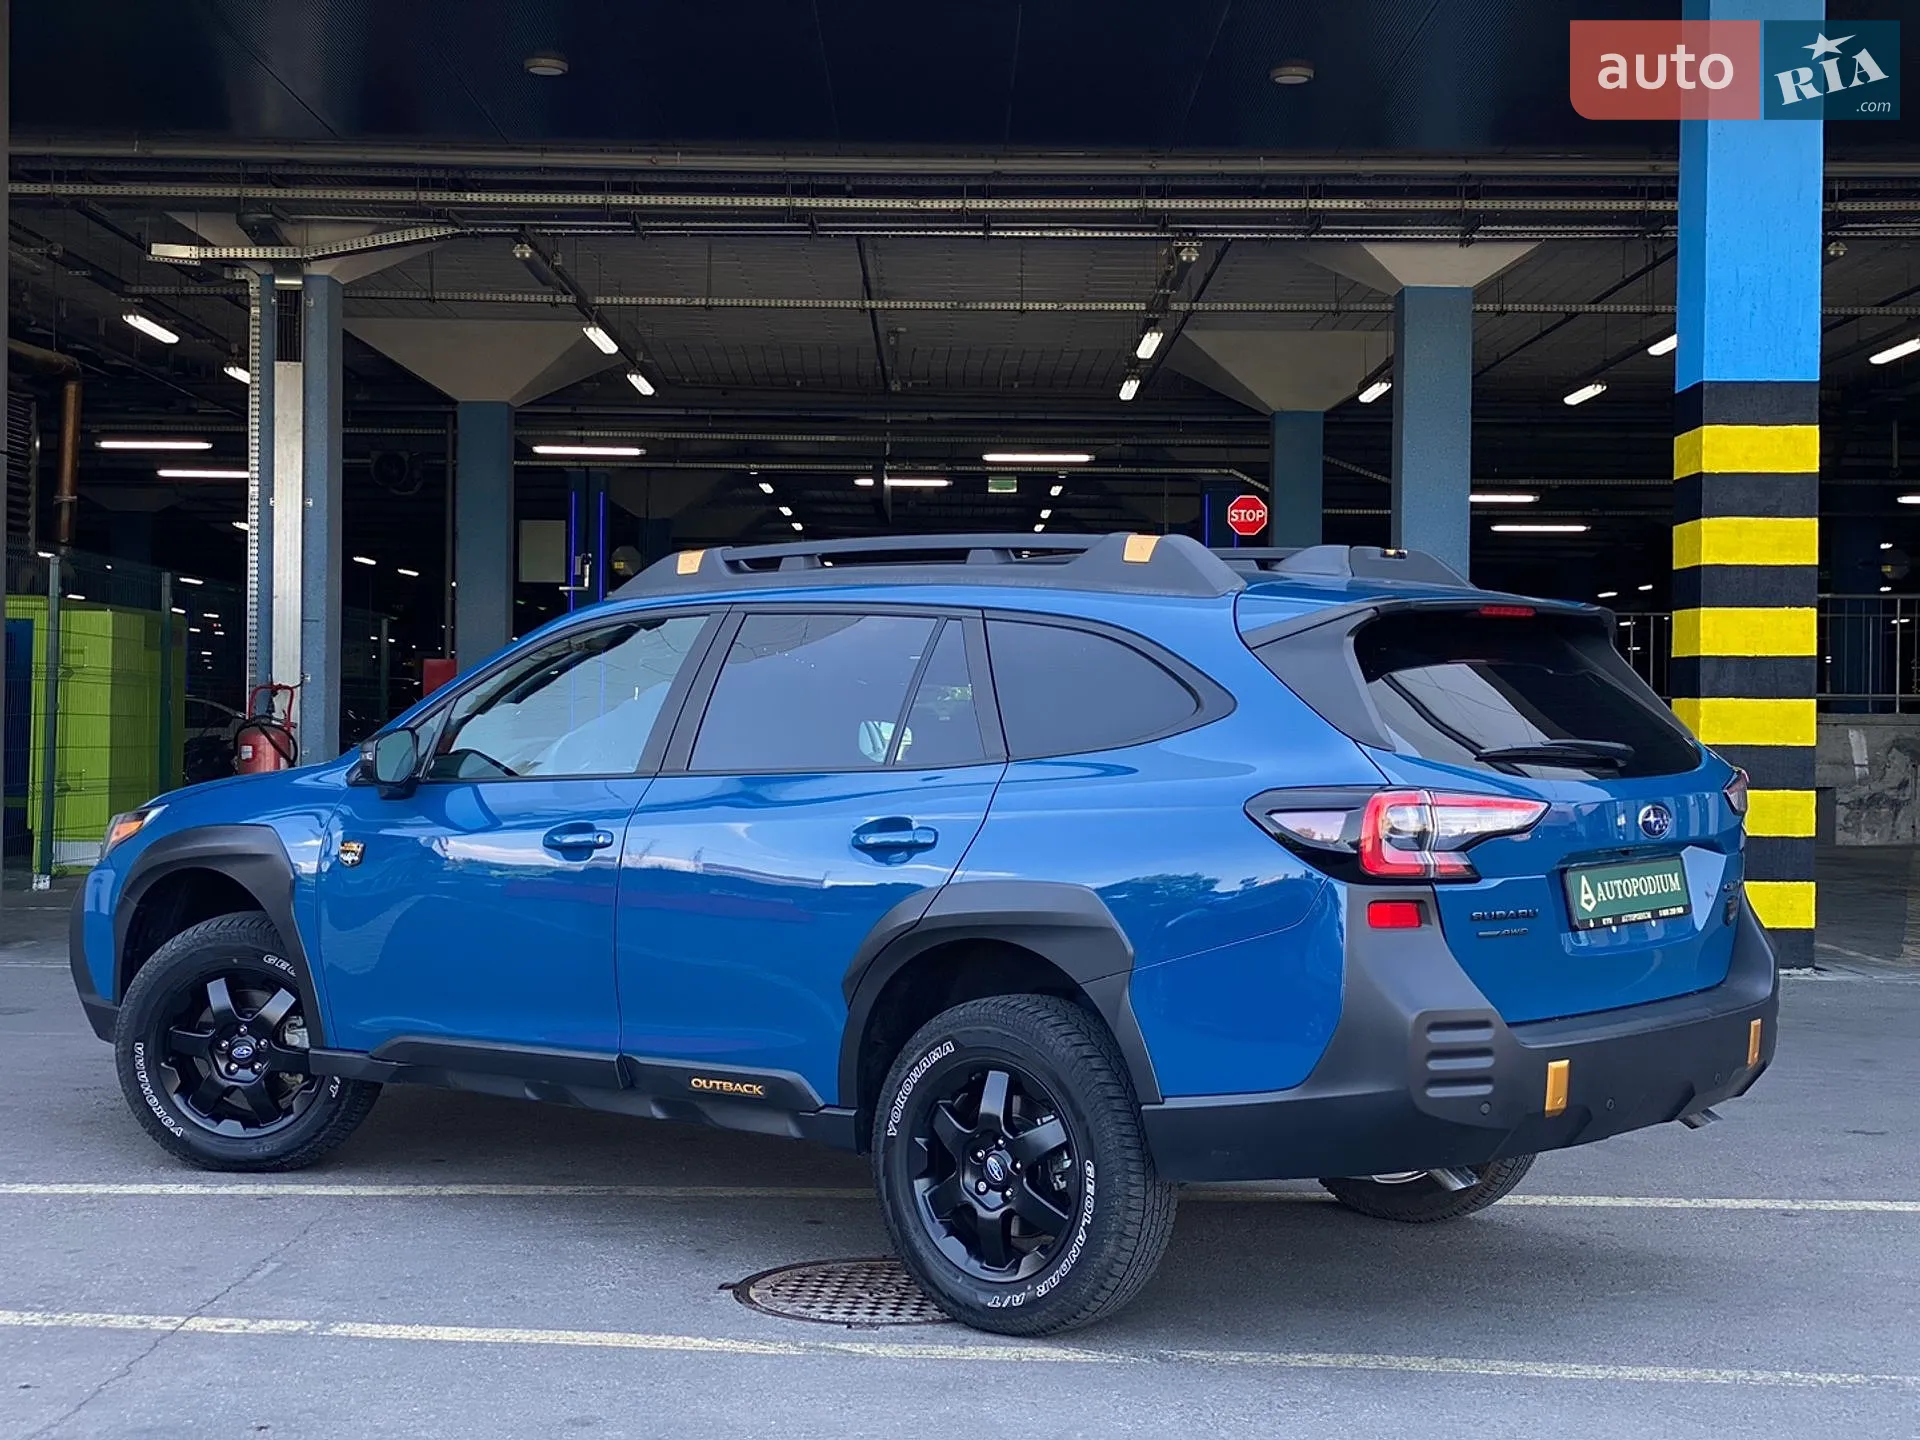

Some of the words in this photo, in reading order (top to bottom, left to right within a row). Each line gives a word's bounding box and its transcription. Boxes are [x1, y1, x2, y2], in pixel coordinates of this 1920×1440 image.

[1230, 509, 1265, 522] STOP
[1597, 871, 1682, 902] AUTOPODIUM
[1471, 908, 1539, 921] SUBARU
[133, 1042, 184, 1138] YOKOHAMA
[690, 1077, 765, 1096] OUTBACK
[887, 1040, 955, 1137] YOKOHAMA
[1036, 1159, 1096, 1298] GEOLANDAR
[987, 1291, 1026, 1308] A/T
